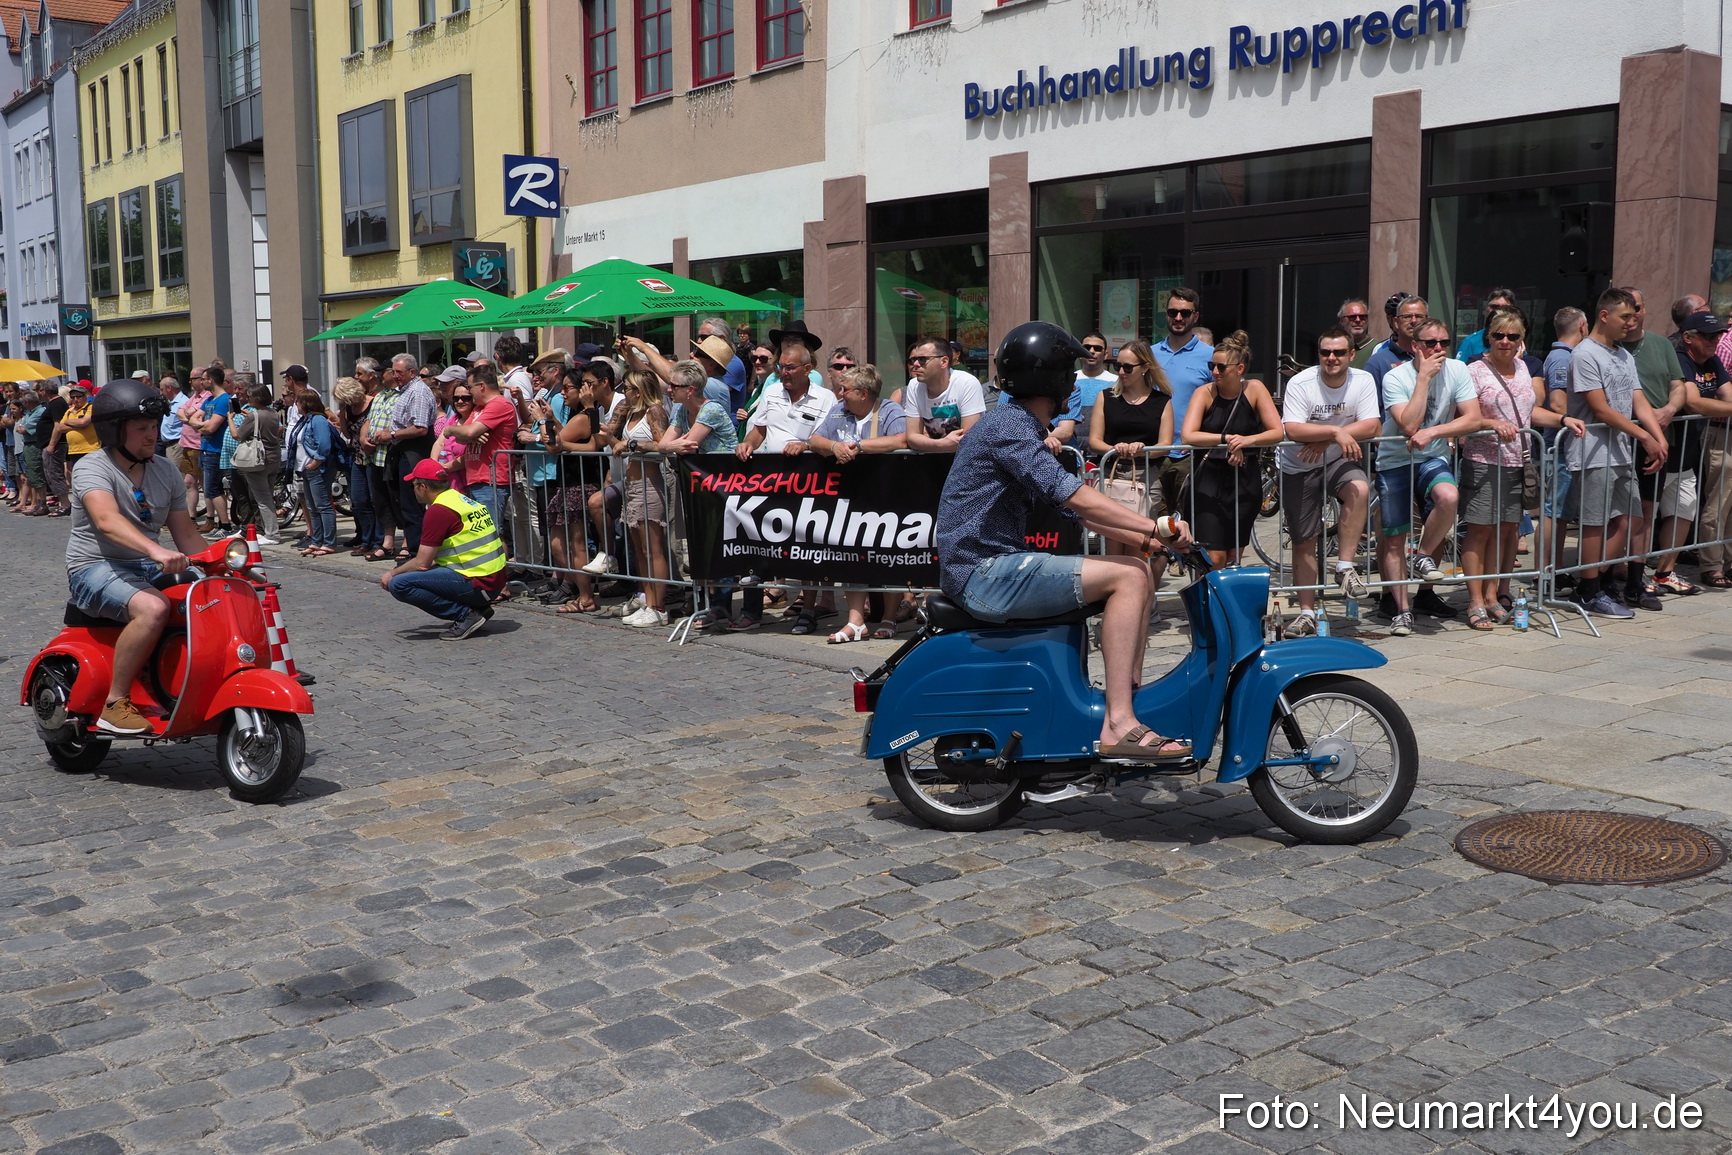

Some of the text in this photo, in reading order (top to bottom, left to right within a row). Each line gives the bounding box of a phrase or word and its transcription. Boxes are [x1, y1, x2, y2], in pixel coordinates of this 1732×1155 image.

[964, 0, 1469, 120] Buchhandlung Rupprecht
[565, 230, 605, 246] Unterer Markt 15
[476, 256, 494, 280] G2
[641, 300, 725, 309] Lammsbräu
[71, 312, 83, 325] G2
[690, 471, 841, 495] FAHRSCHULE
[467, 507, 489, 523] FOLLO
[722, 495, 938, 550] Kohlma
[722, 542, 932, 568] Neumarkt Burgthann Freystadt
